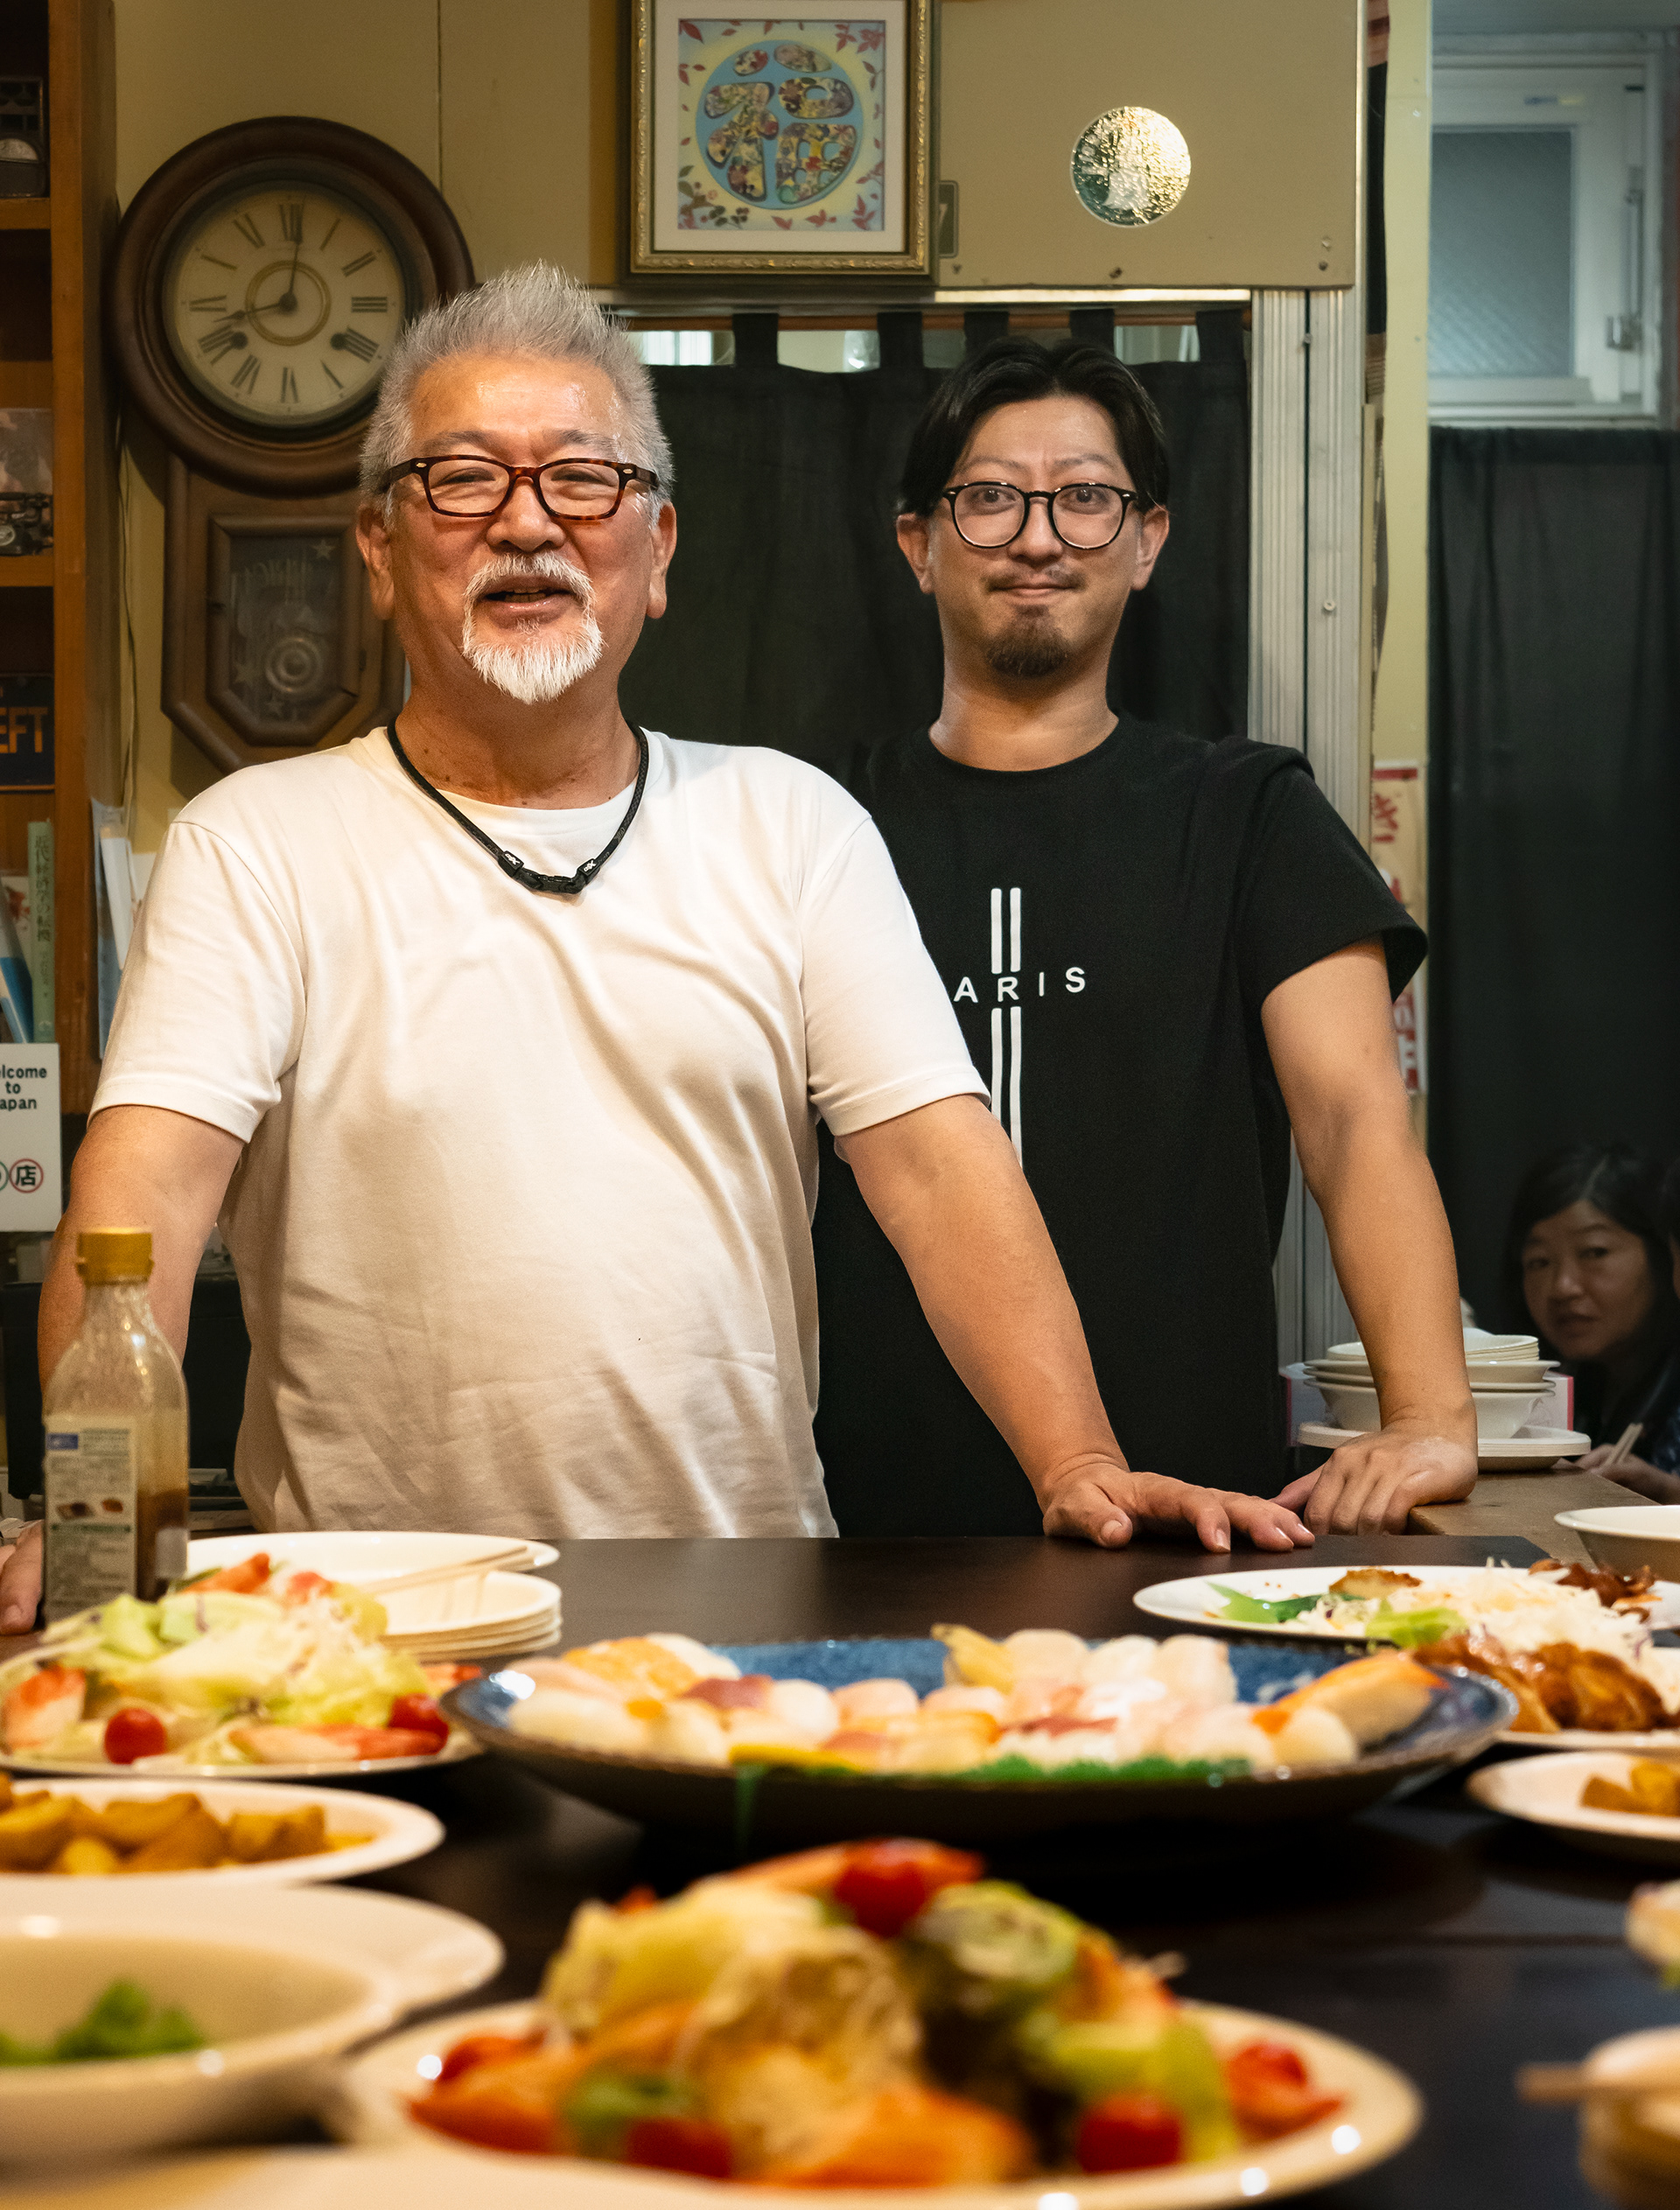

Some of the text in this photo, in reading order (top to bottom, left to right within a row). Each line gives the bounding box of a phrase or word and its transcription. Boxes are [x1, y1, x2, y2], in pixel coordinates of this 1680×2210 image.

[351, 296, 388, 313] III
[953, 967, 1086, 1004] ARIS
[0, 1065, 47, 1079] lcome
[5, 1081, 21, 1094] to
[15, 1164, 37, 1186] 店
